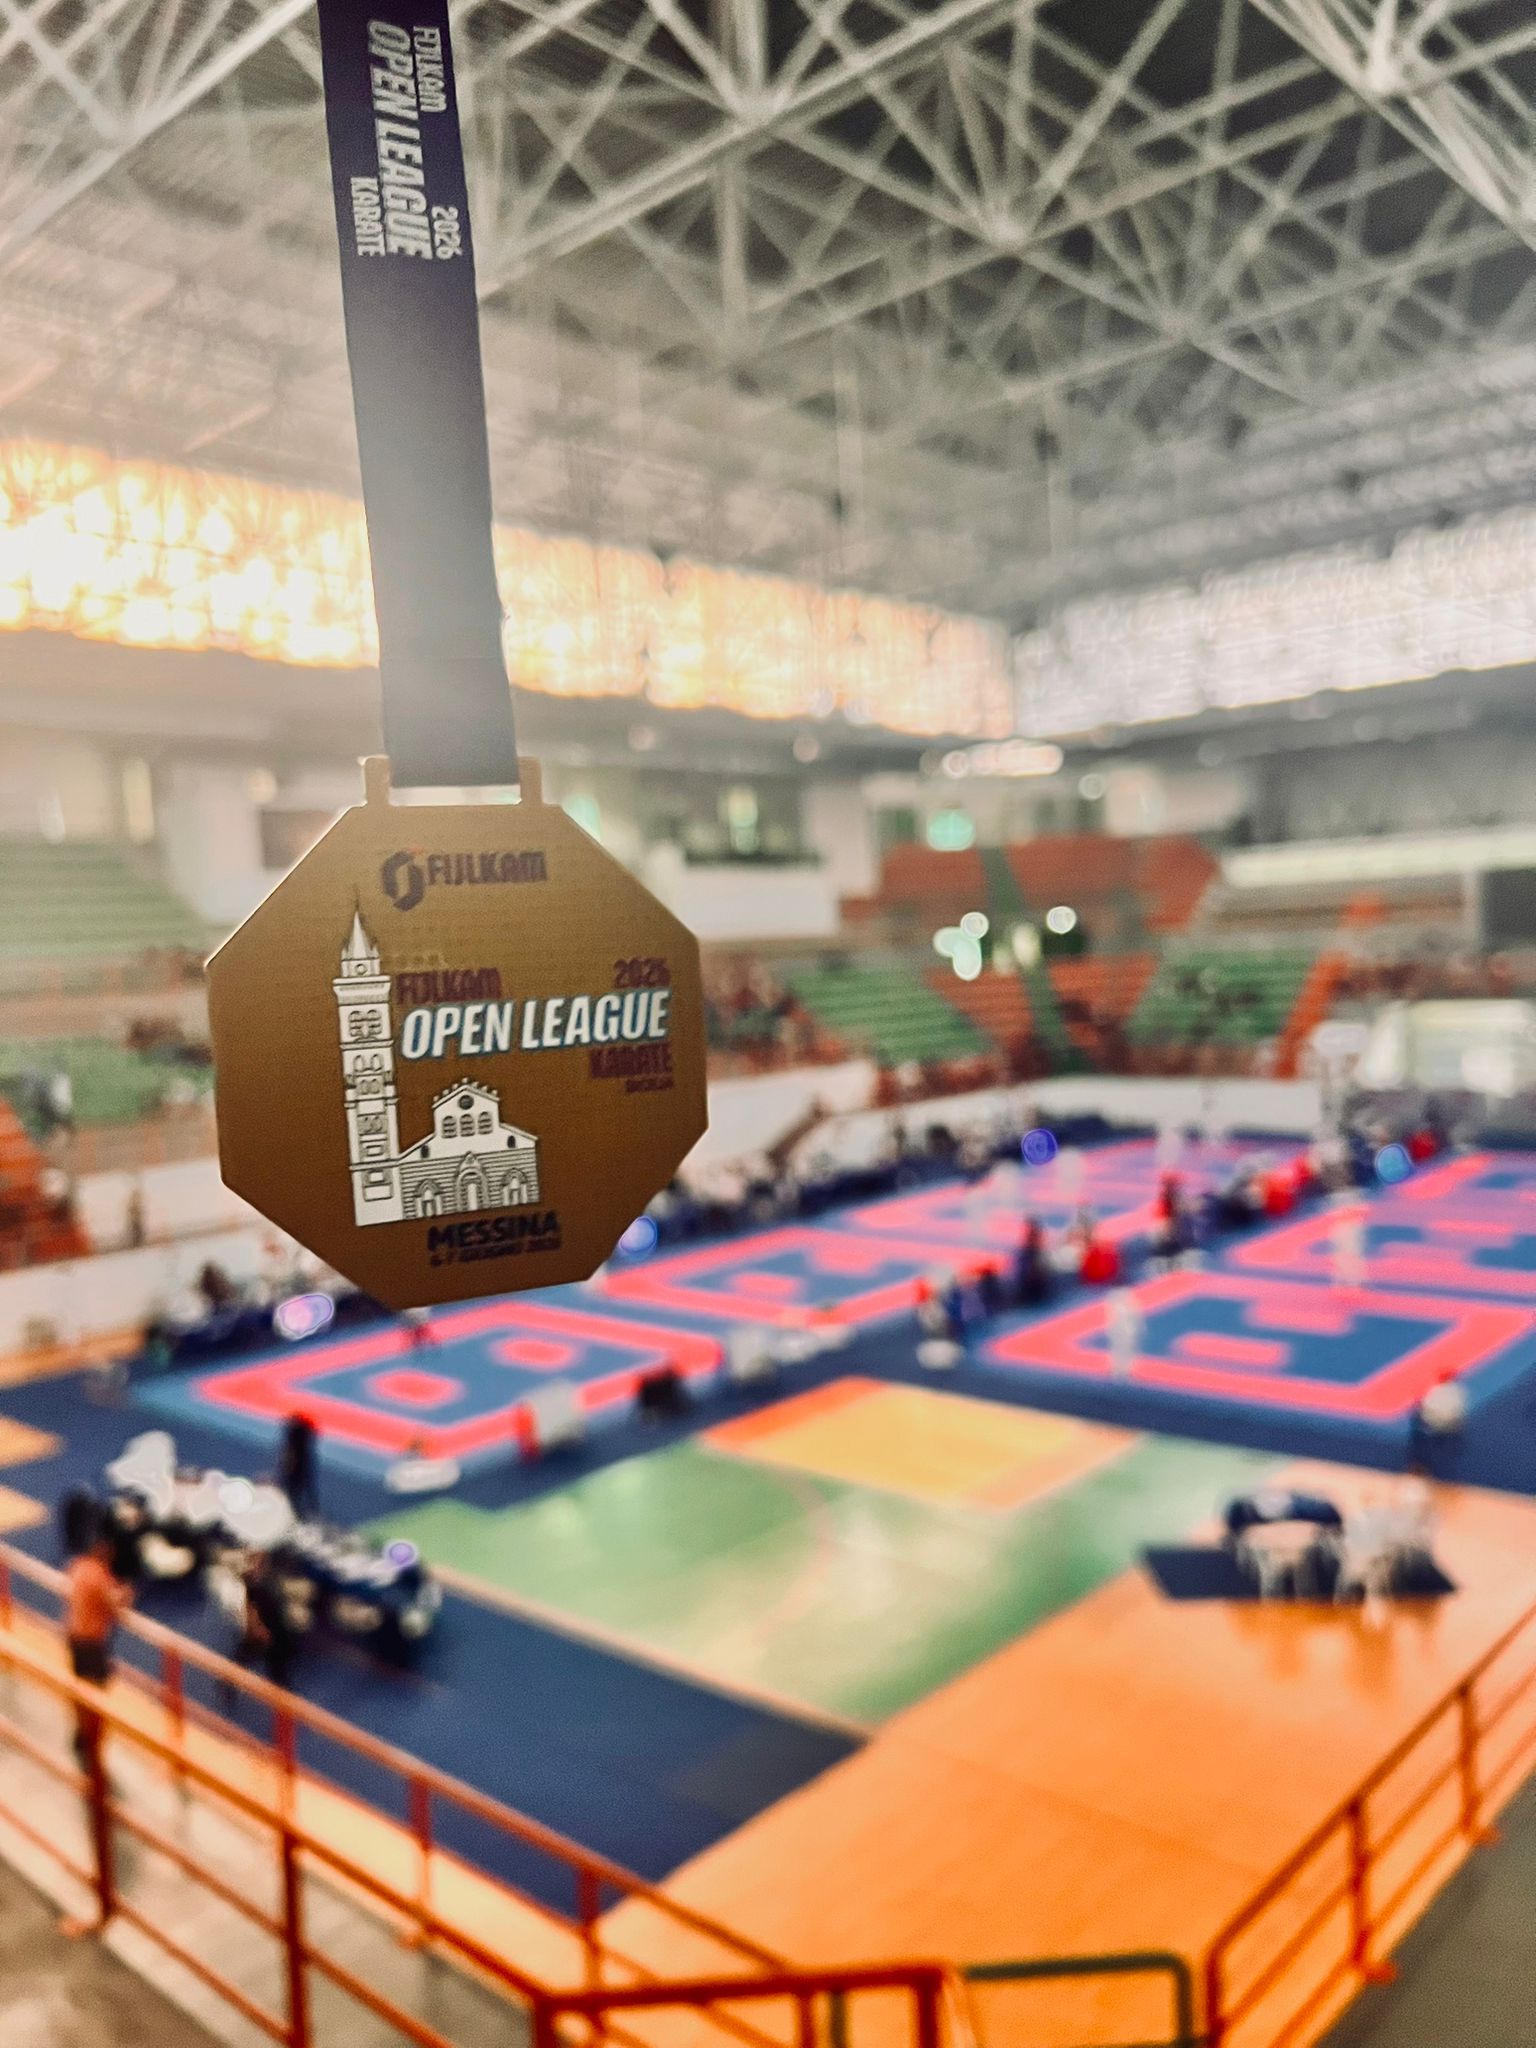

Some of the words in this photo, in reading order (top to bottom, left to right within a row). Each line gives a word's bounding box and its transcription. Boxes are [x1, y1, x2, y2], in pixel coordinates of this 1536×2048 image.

[368, 20, 418, 120] OPEN
[351, 176, 386, 257] KARATE
[375, 118, 432, 260] LEAGUE
[431, 206, 462, 259] 2026
[402, 1001, 513, 1059] OPEN
[521, 989, 670, 1050] LEAGUE
[427, 1209, 559, 1252] MESSINA
